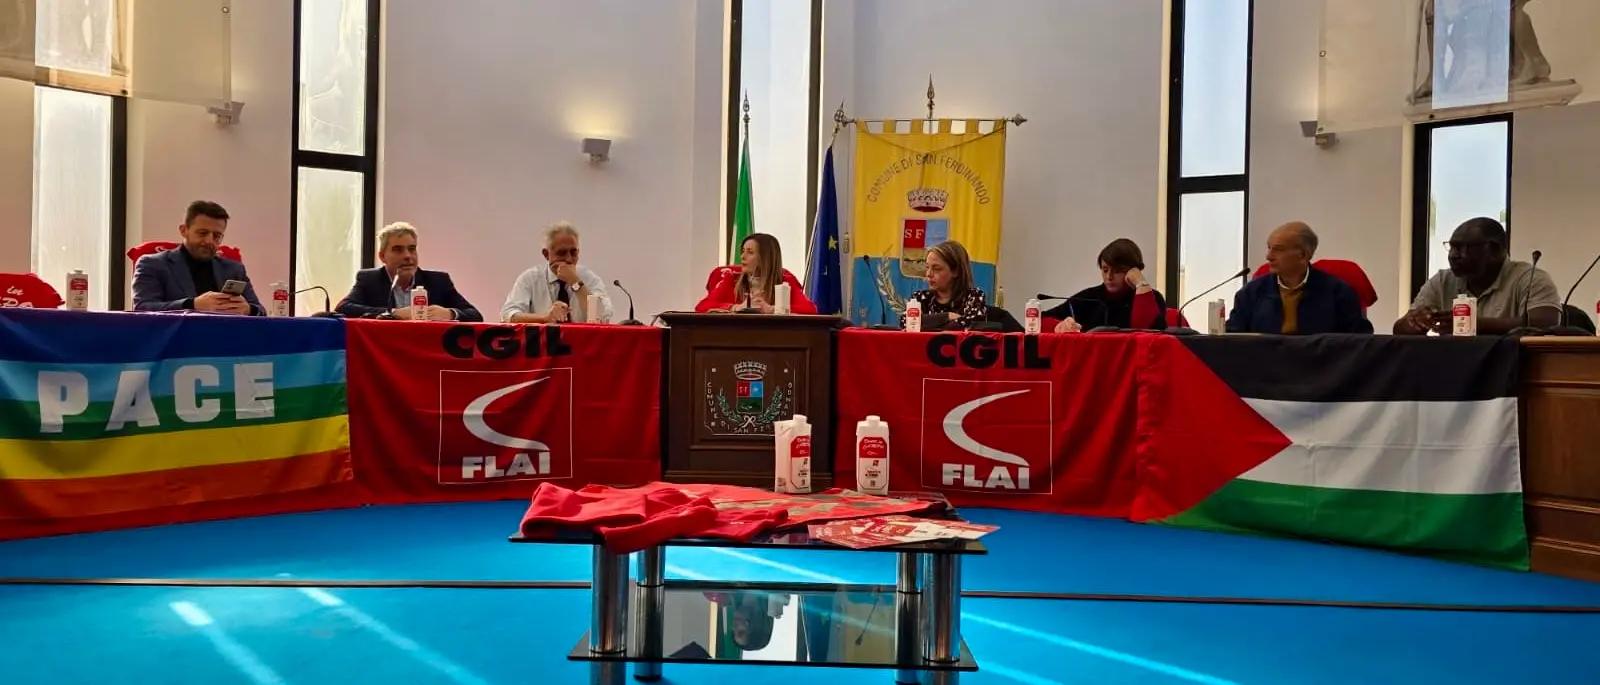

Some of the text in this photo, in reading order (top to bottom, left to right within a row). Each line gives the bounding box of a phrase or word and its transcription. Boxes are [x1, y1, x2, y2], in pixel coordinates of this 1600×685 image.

[867, 154, 991, 205] COMUNE DI SAN FERDINANDO
[442, 325, 573, 360] CGIL
[926, 334, 1052, 369] CGIL
[37, 362, 275, 433] PACE
[706, 382, 718, 419] COMUNE
[462, 451, 550, 479] FLAI
[942, 463, 1030, 489] FLAI
